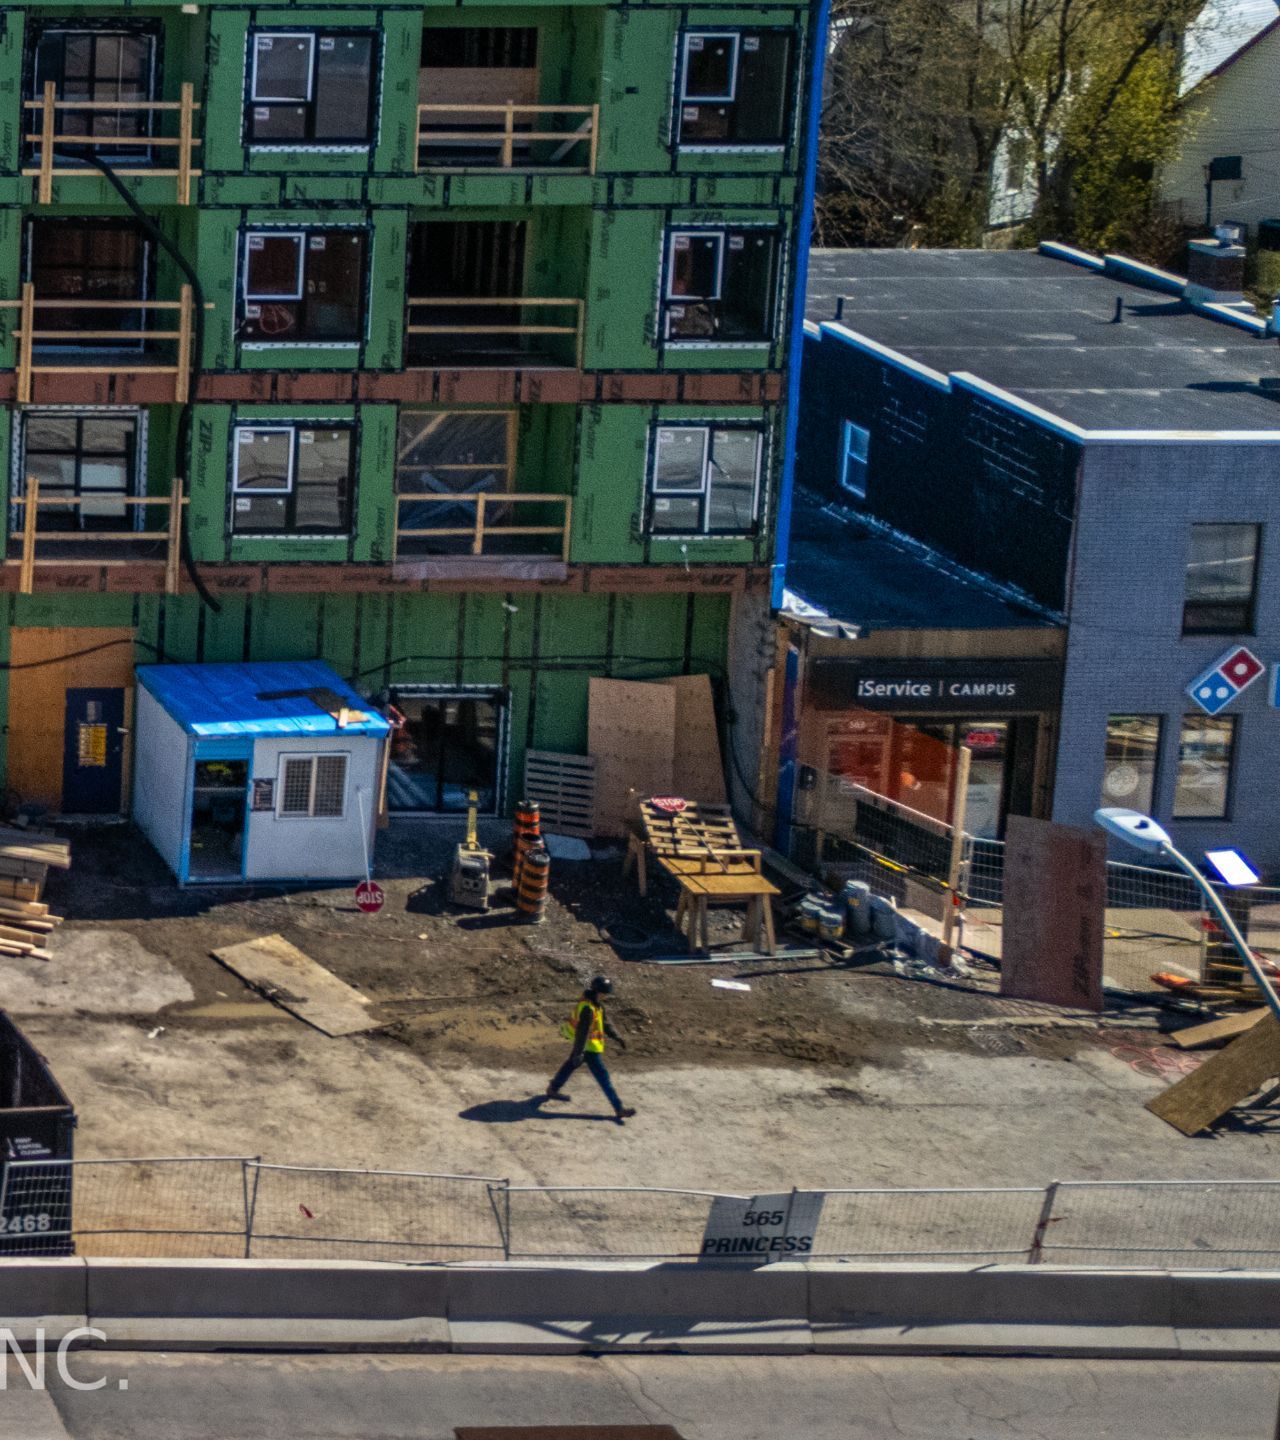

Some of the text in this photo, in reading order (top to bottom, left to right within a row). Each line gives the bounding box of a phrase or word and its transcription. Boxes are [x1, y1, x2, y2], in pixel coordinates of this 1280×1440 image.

[857, 680, 1016, 697] iService CAMPUS
[357, 890, 384, 905] STOP
[742, 1210, 784, 1227] 565
[702, 1236, 812, 1253] PRINCESS
